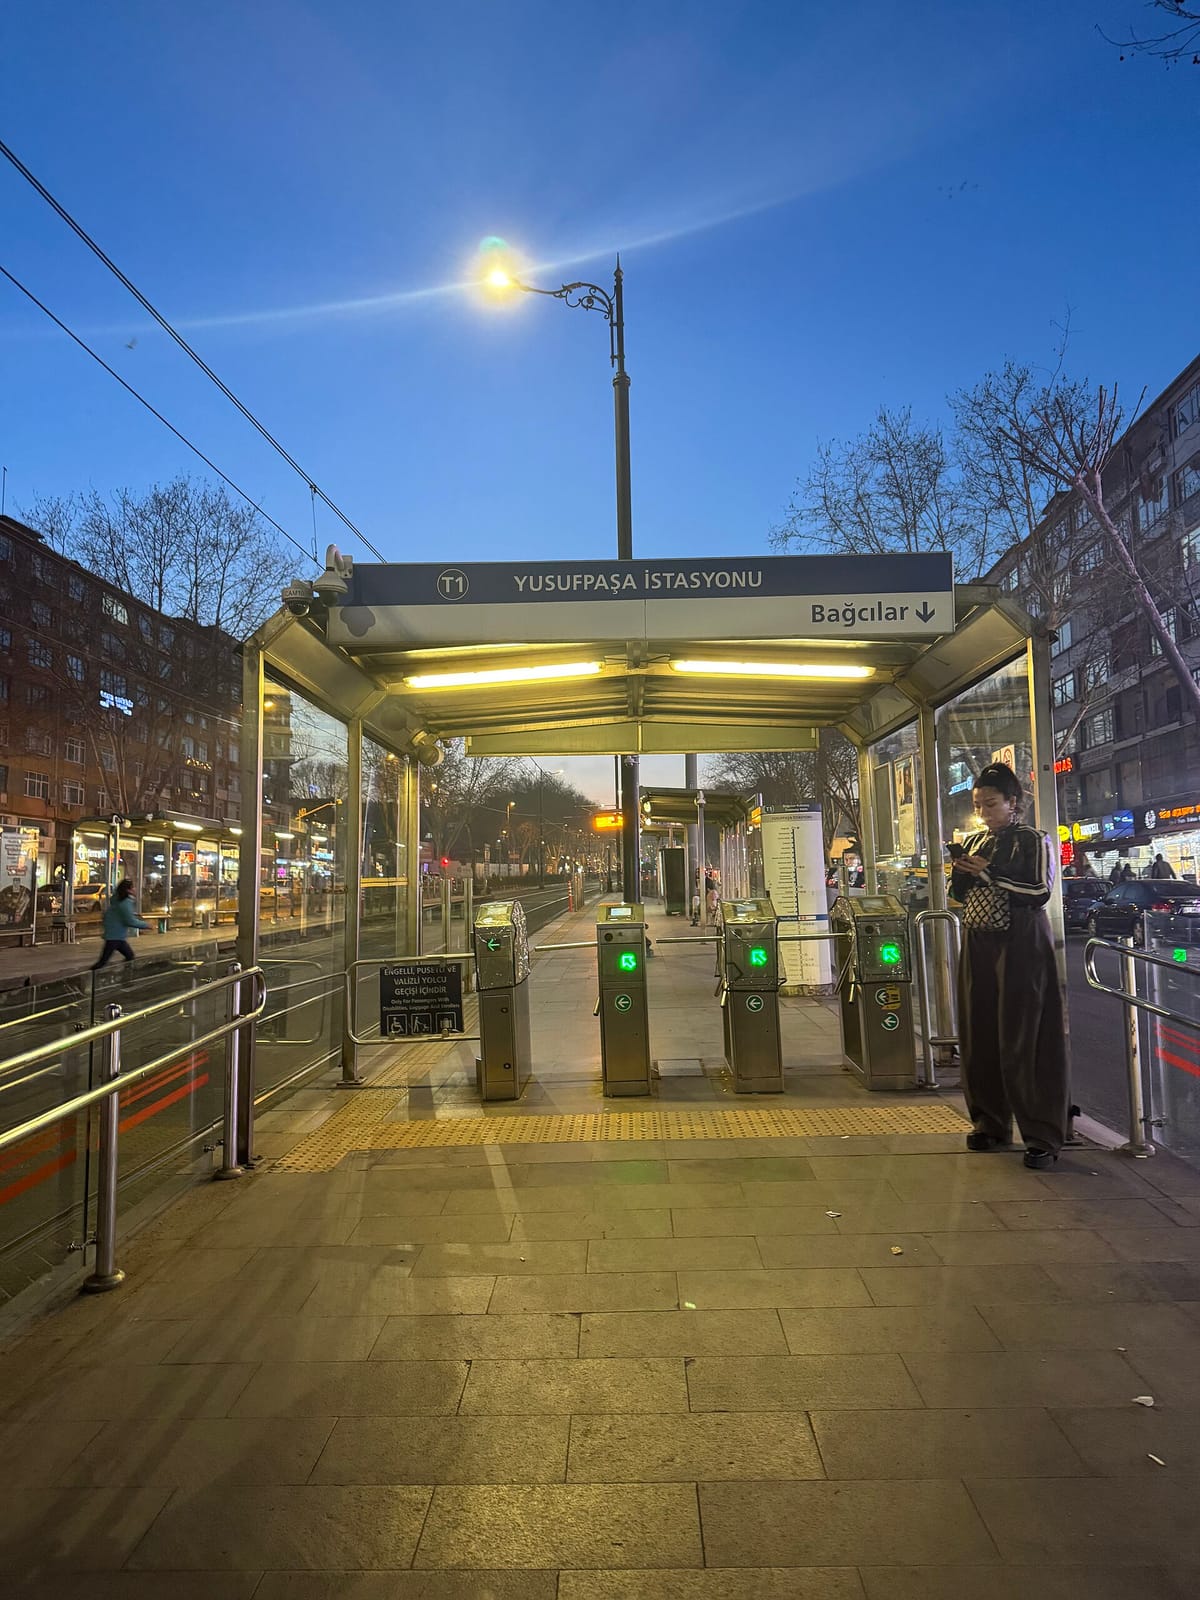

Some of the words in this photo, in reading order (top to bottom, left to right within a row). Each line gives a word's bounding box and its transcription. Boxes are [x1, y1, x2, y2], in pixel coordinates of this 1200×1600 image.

[441, 576, 463, 593] T1
[513, 573, 637, 595] YUSUFPAŞA
[644, 569, 762, 589] İSTASYONU
[811, 600, 909, 627] Bağcılar
[447, 965, 457, 973] VE
[393, 976, 420, 985] VALİZLİ
[421, 976, 447, 984] YOLCU
